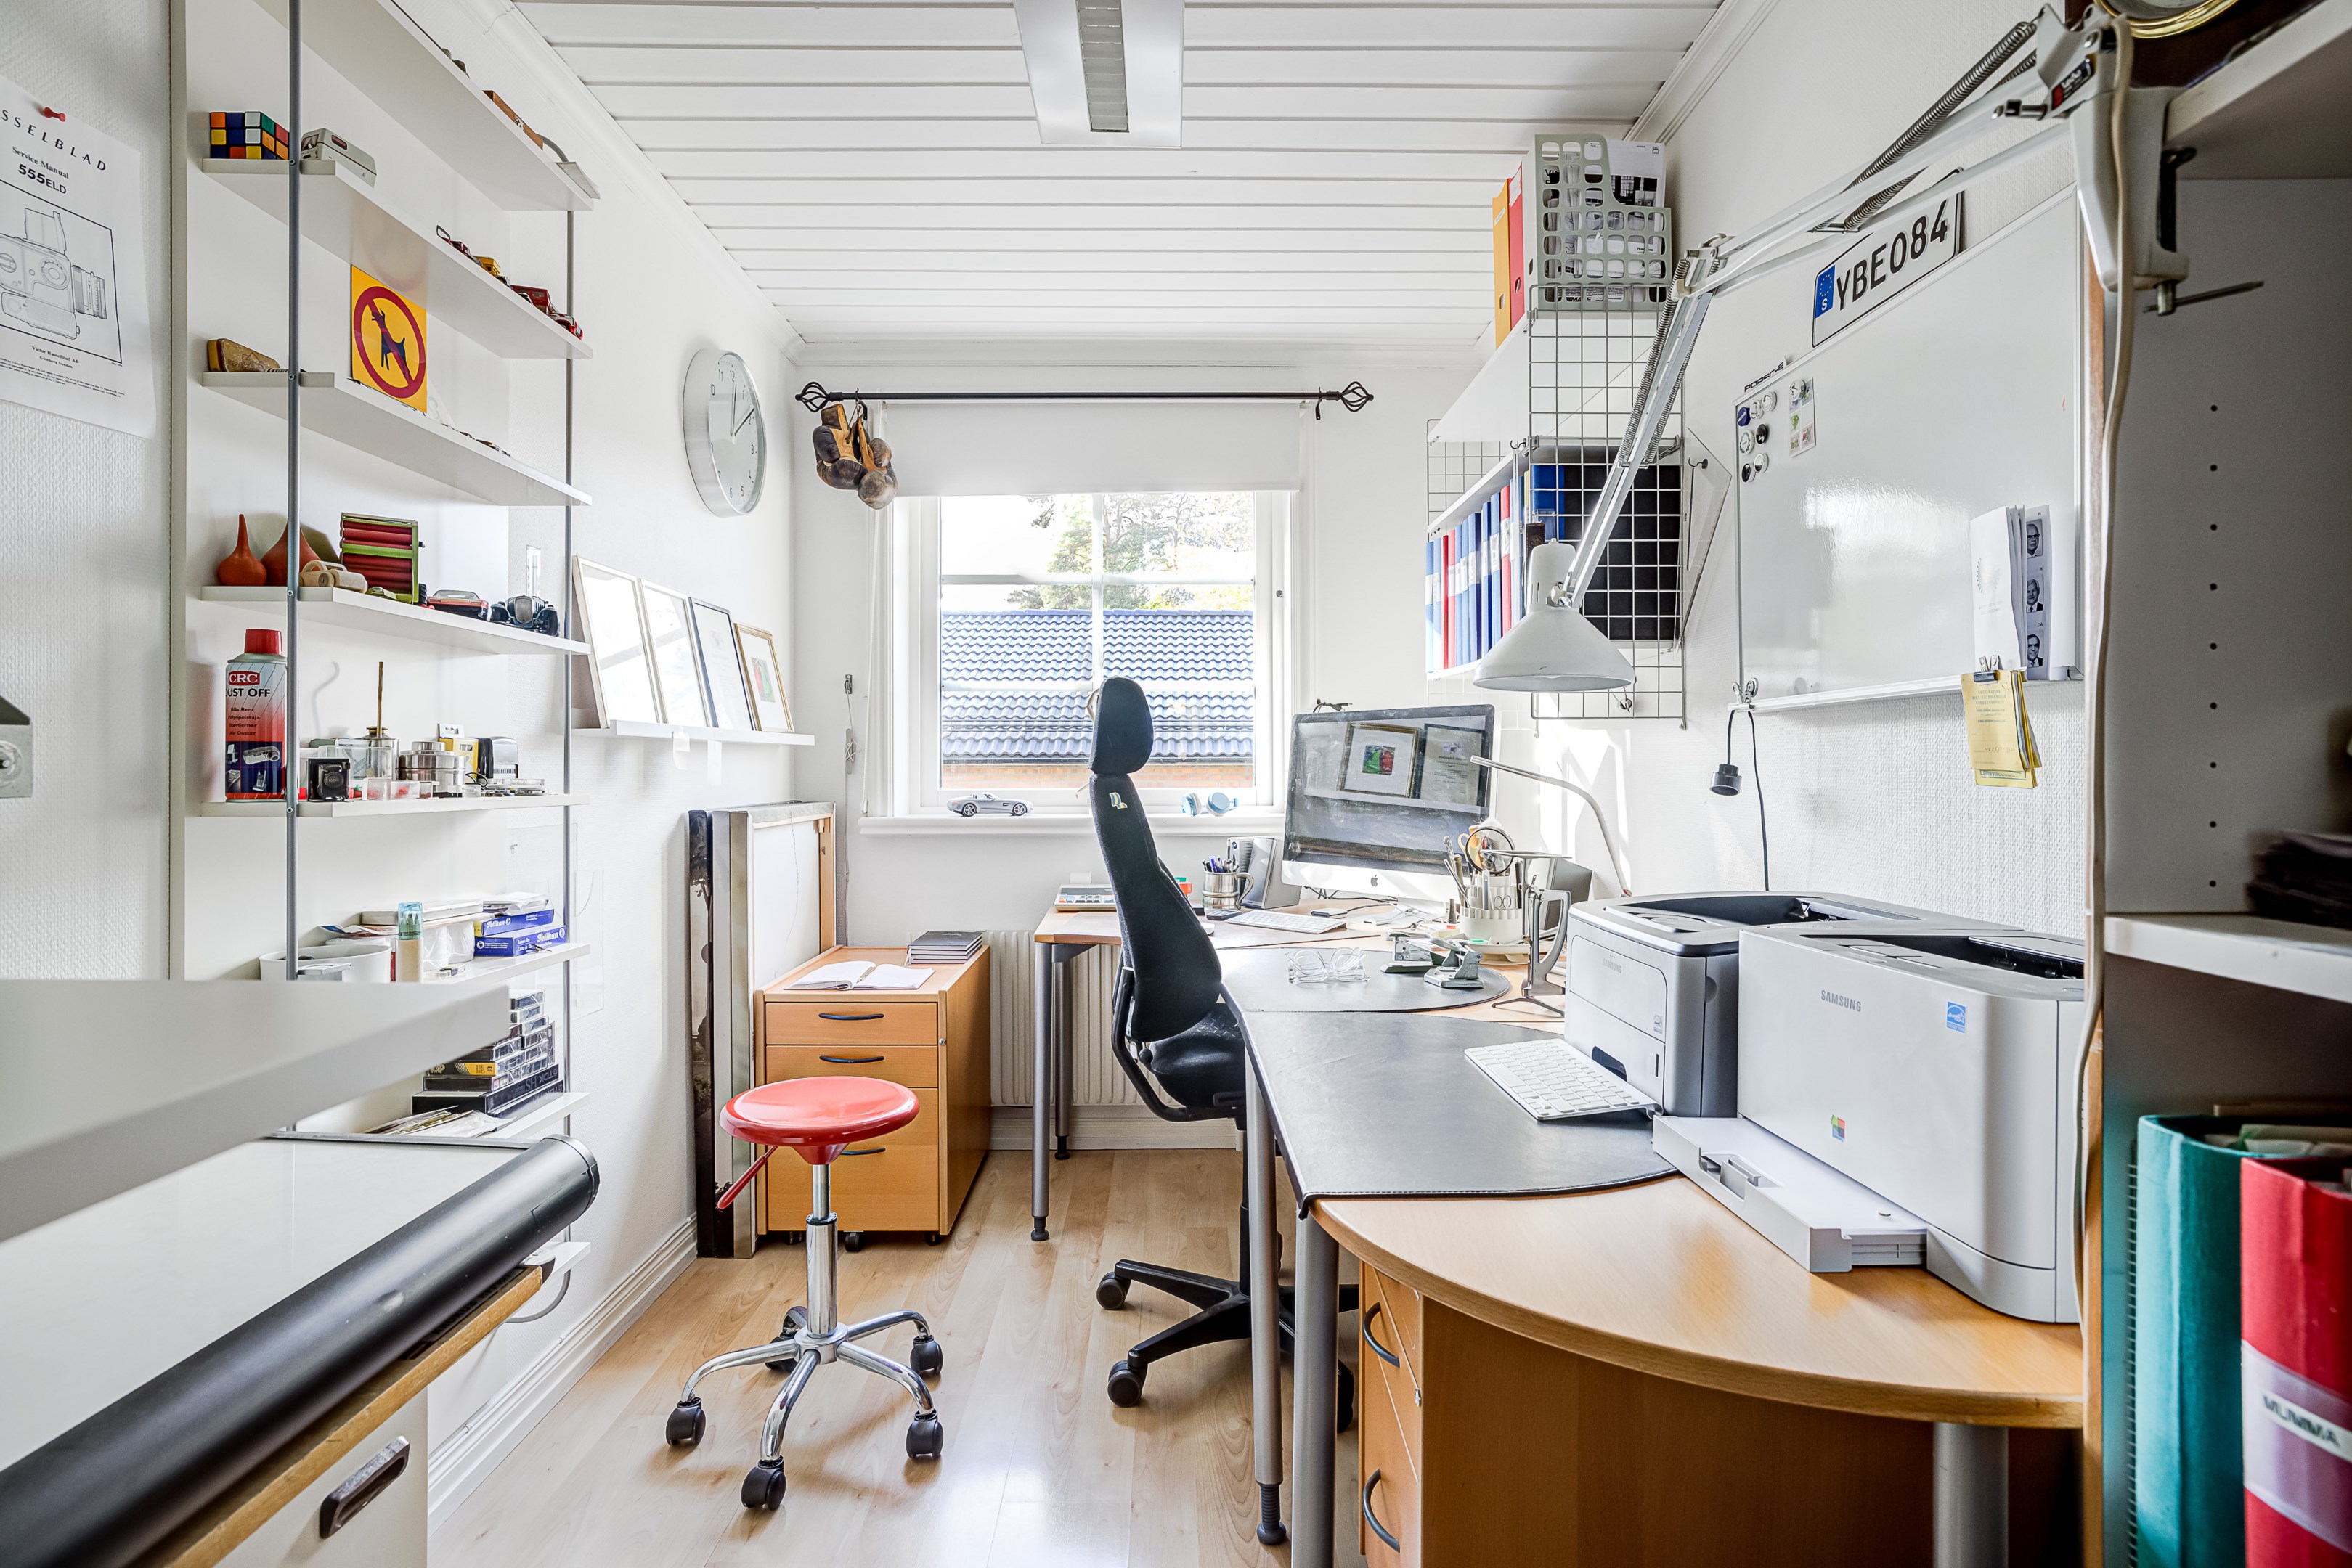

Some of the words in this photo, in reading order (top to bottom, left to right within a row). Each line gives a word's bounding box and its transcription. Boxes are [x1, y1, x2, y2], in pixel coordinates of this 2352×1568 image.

[12, 146, 38, 165] Service
[41, 160, 69, 179] Manual
[18, 163, 67, 194] 555ELD
[1821, 298, 1828, 311] S
[718, 369, 723, 381] 11
[730, 369, 735, 383] 12
[229, 673, 258, 683] CRC
[248, 688, 271, 697] OFF
[486, 920, 505, 928] Pelikan
[537, 931, 558, 943] Pelikan
[1820, 989, 1862, 1013] SAMSUNG
[525, 1074, 537, 1089] HS
[540, 1071, 558, 1082] TDK
